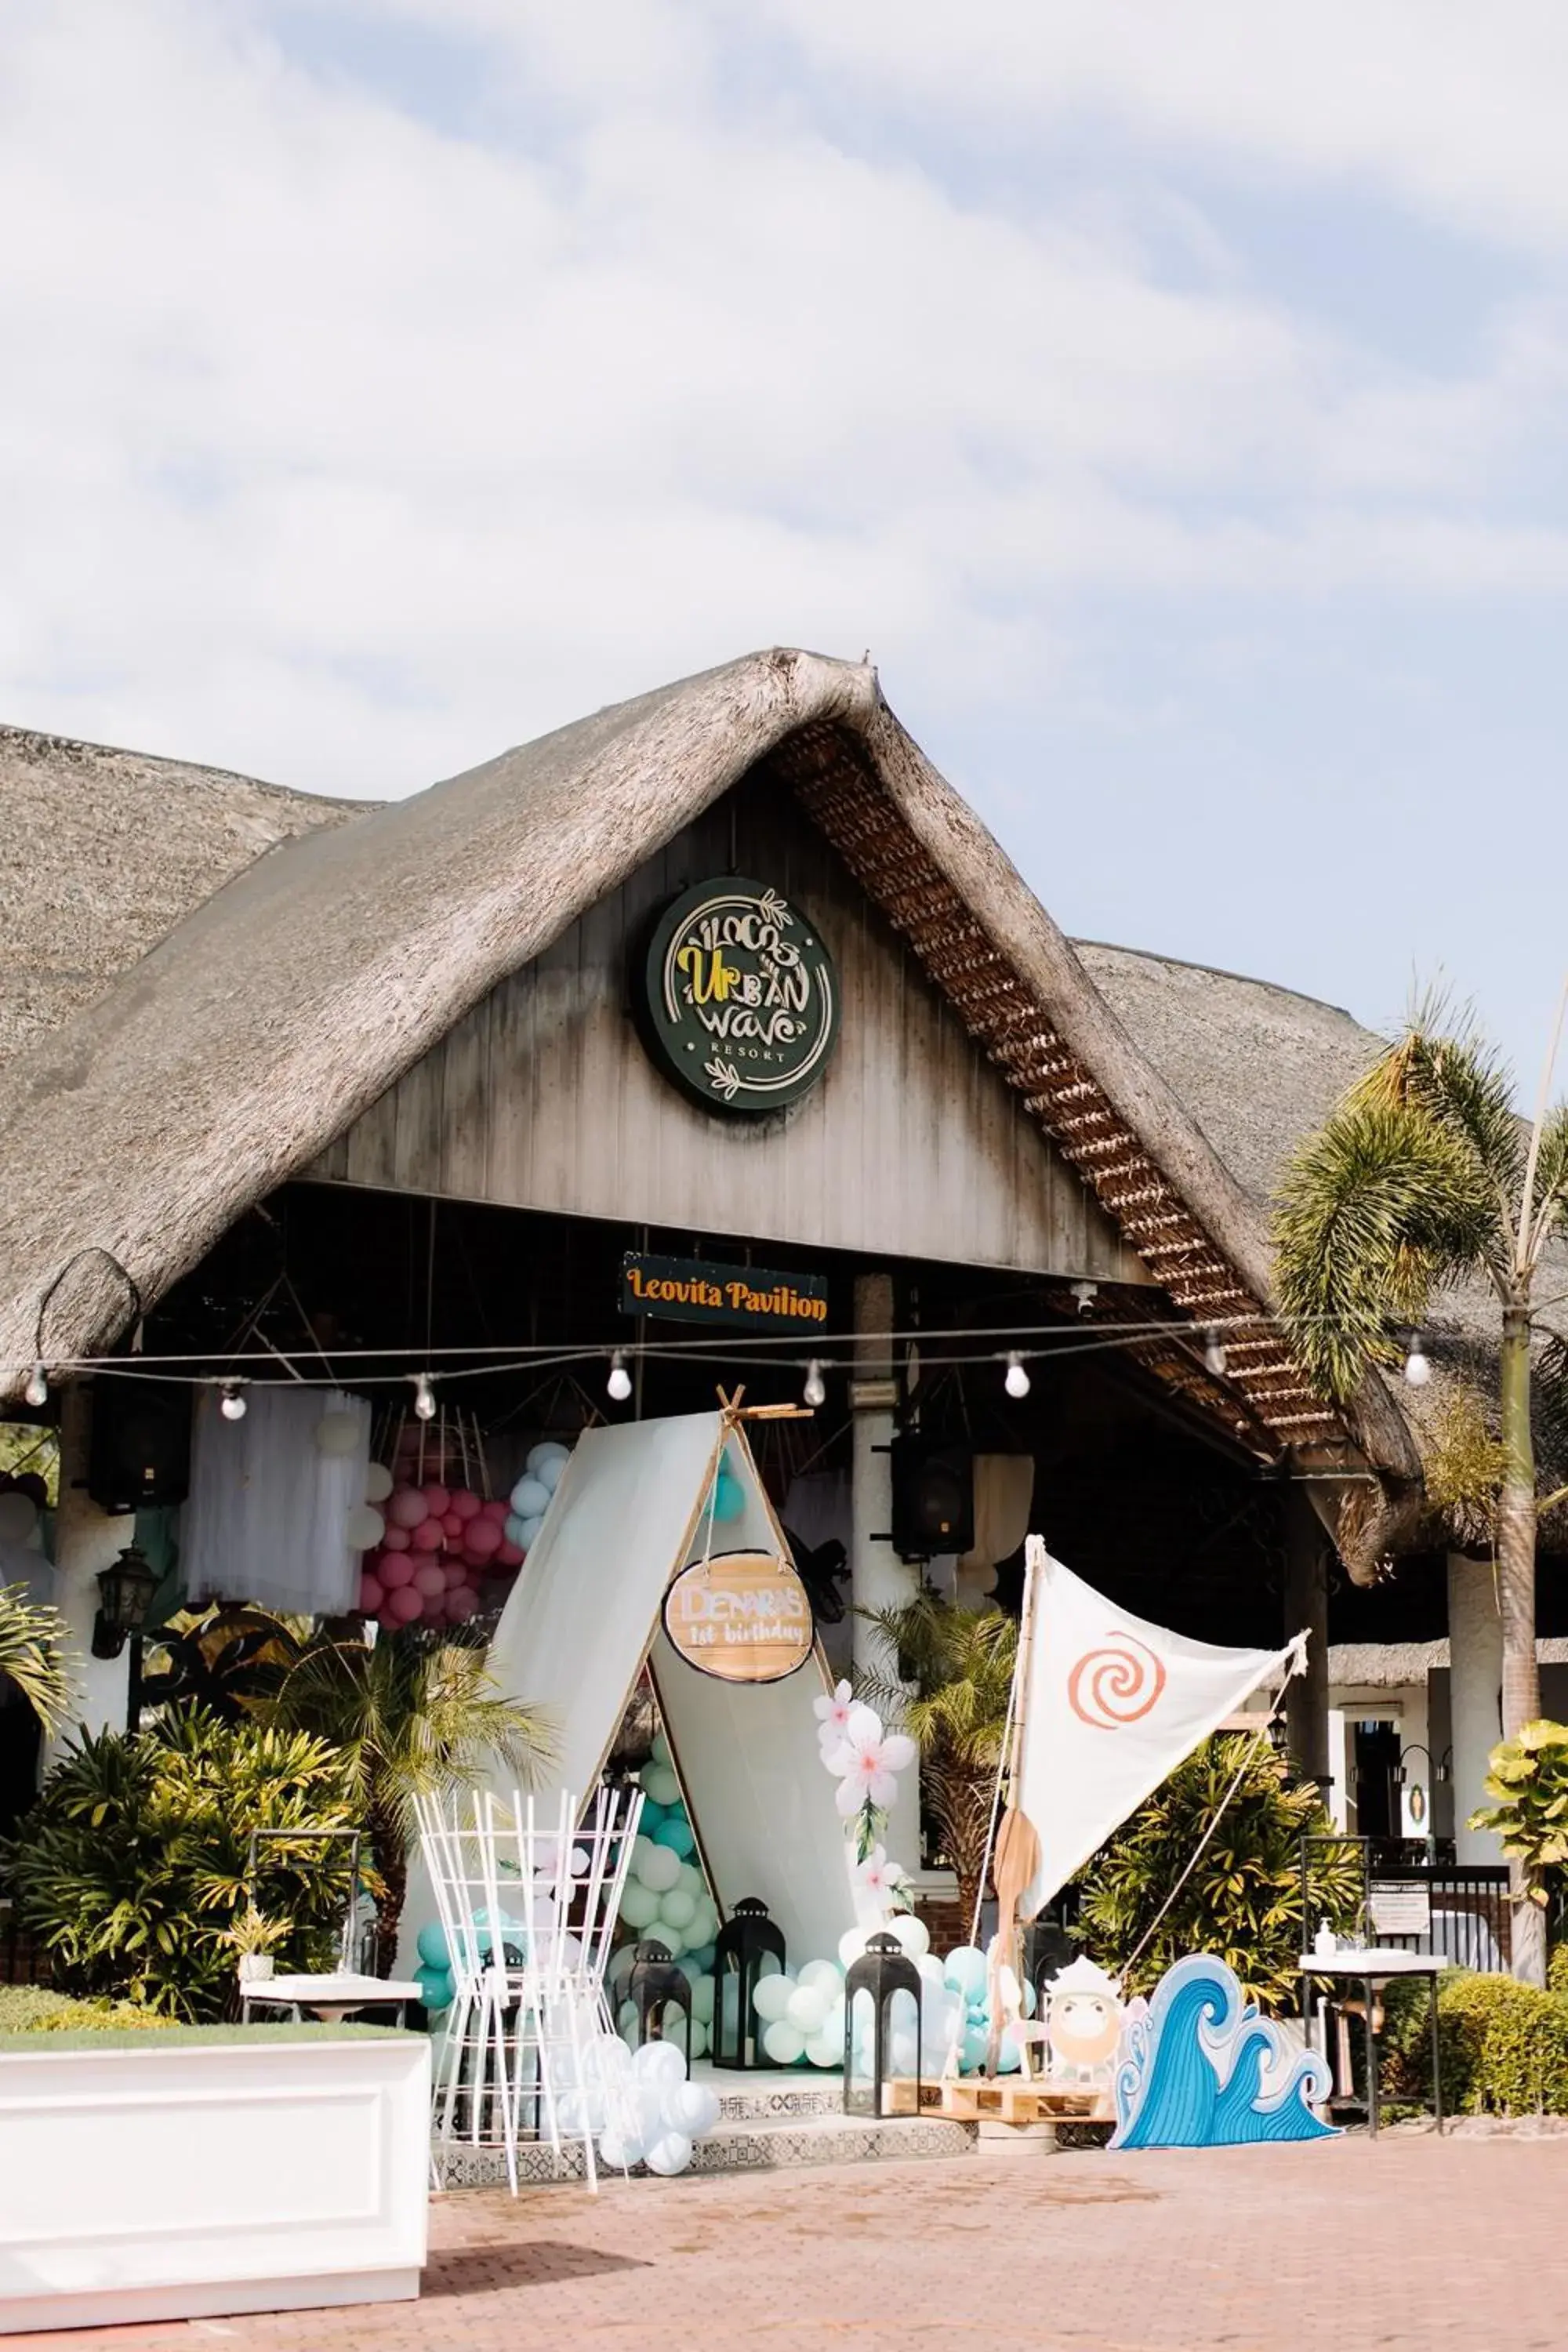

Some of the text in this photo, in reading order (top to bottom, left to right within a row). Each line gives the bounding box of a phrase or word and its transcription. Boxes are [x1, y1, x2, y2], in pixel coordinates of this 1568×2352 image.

[711, 1043, 785, 1063] RESORT
[627, 1268, 827, 1322] Leovita Pavilion
[724, 1619, 803, 1646] birthday
